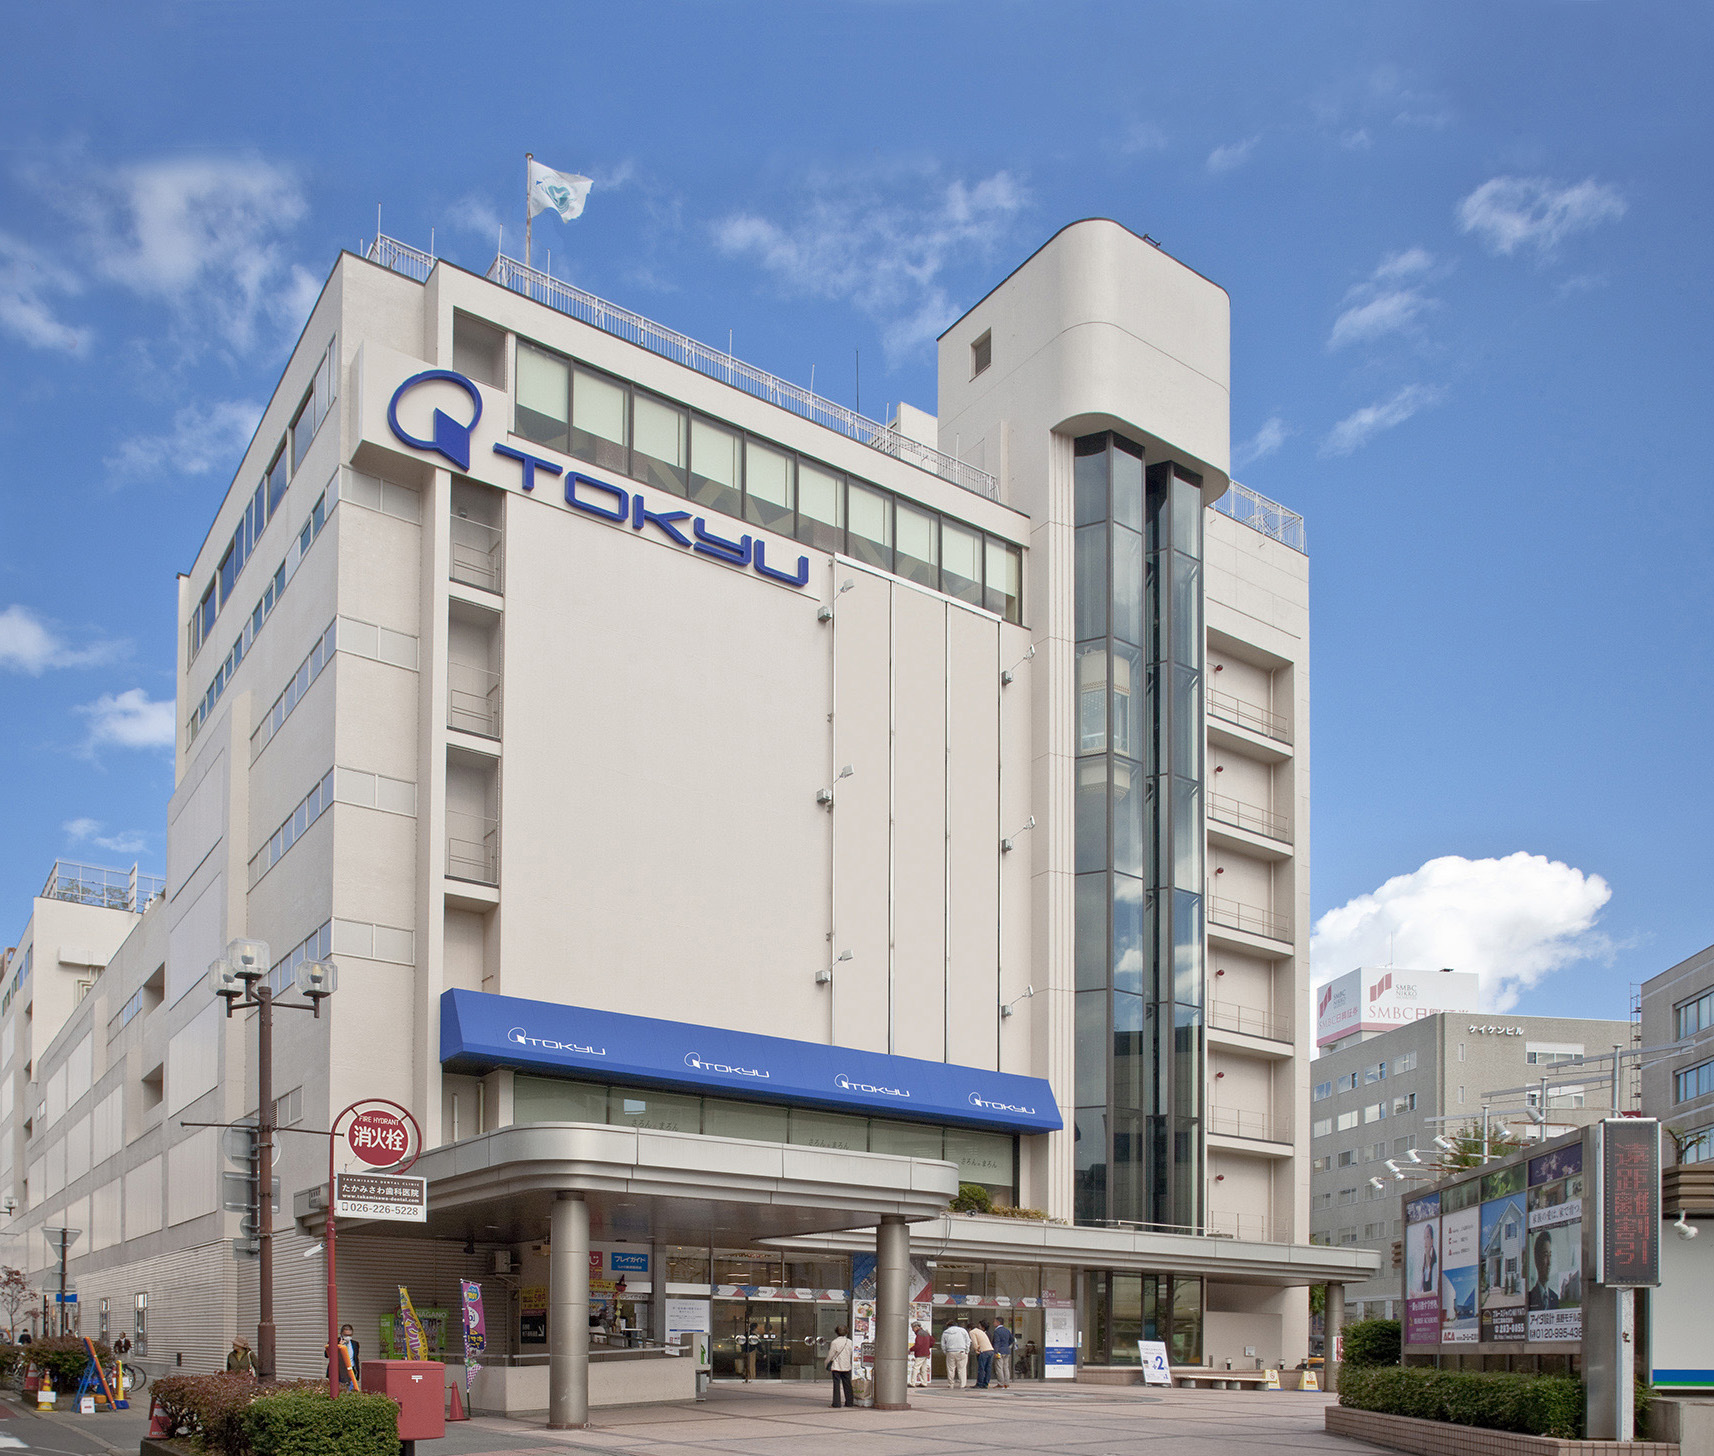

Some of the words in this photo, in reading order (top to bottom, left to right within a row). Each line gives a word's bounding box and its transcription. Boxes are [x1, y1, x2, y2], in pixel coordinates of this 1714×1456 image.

[492, 442, 809, 588] TOKYU
[1369, 1006, 1469, 1020] SMBC日興
[1468, 1024, 1524, 1036] ケイケンビル
[525, 1037, 606, 1056] TOKYU
[699, 1062, 770, 1079] TOKYU
[848, 1082, 911, 1098] TOKYU
[979, 1100, 1036, 1115] TOKYU
[359, 1115, 371, 1123] FIRE
[373, 1117, 400, 1126] HYDRANT
[353, 1125, 405, 1151] 消火栓
[342, 1184, 419, 1197] たかみさわ歯科医院
[350, 1203, 419, 1216] 026-226-5228
[614, 1255, 646, 1263] プレイガイド
